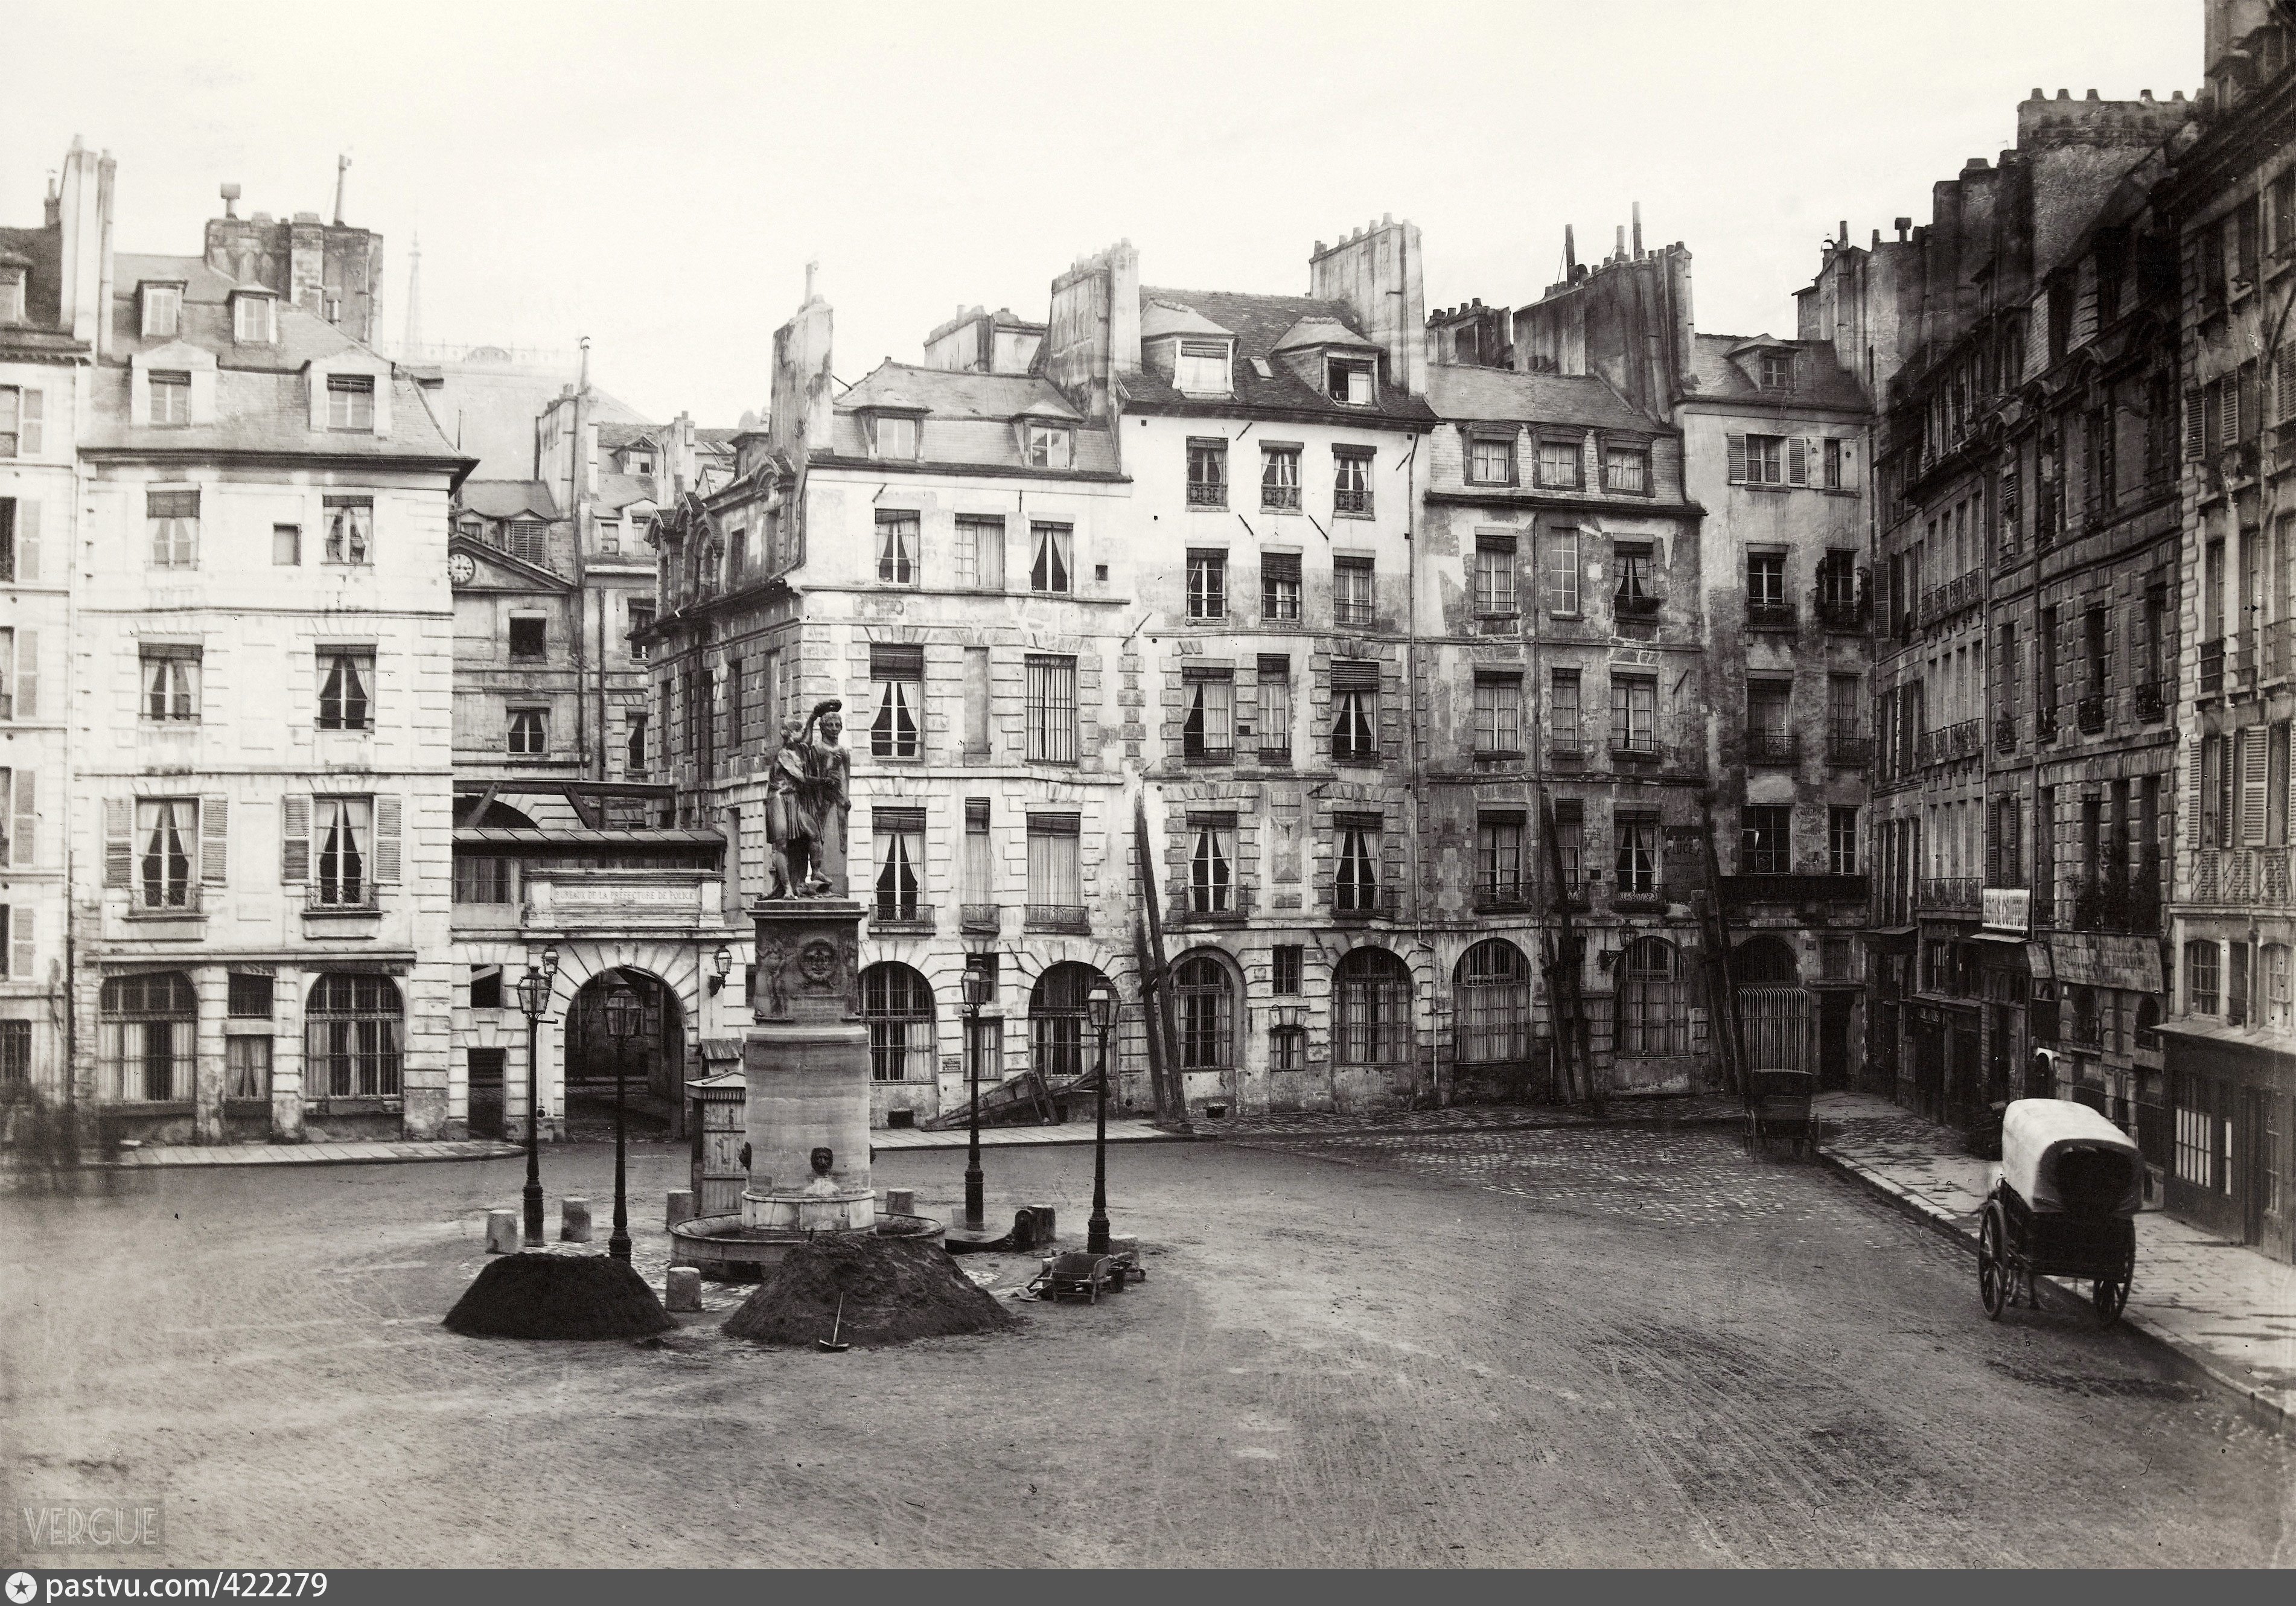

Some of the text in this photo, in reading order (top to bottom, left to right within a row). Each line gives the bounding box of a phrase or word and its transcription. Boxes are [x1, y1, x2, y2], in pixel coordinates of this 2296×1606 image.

[555, 890, 585, 899] BUREAUX
[587, 890, 596, 899] DE
[599, 890, 608, 899] LA
[659, 890, 667, 899] DE
[669, 890, 694, 900] POLICE
